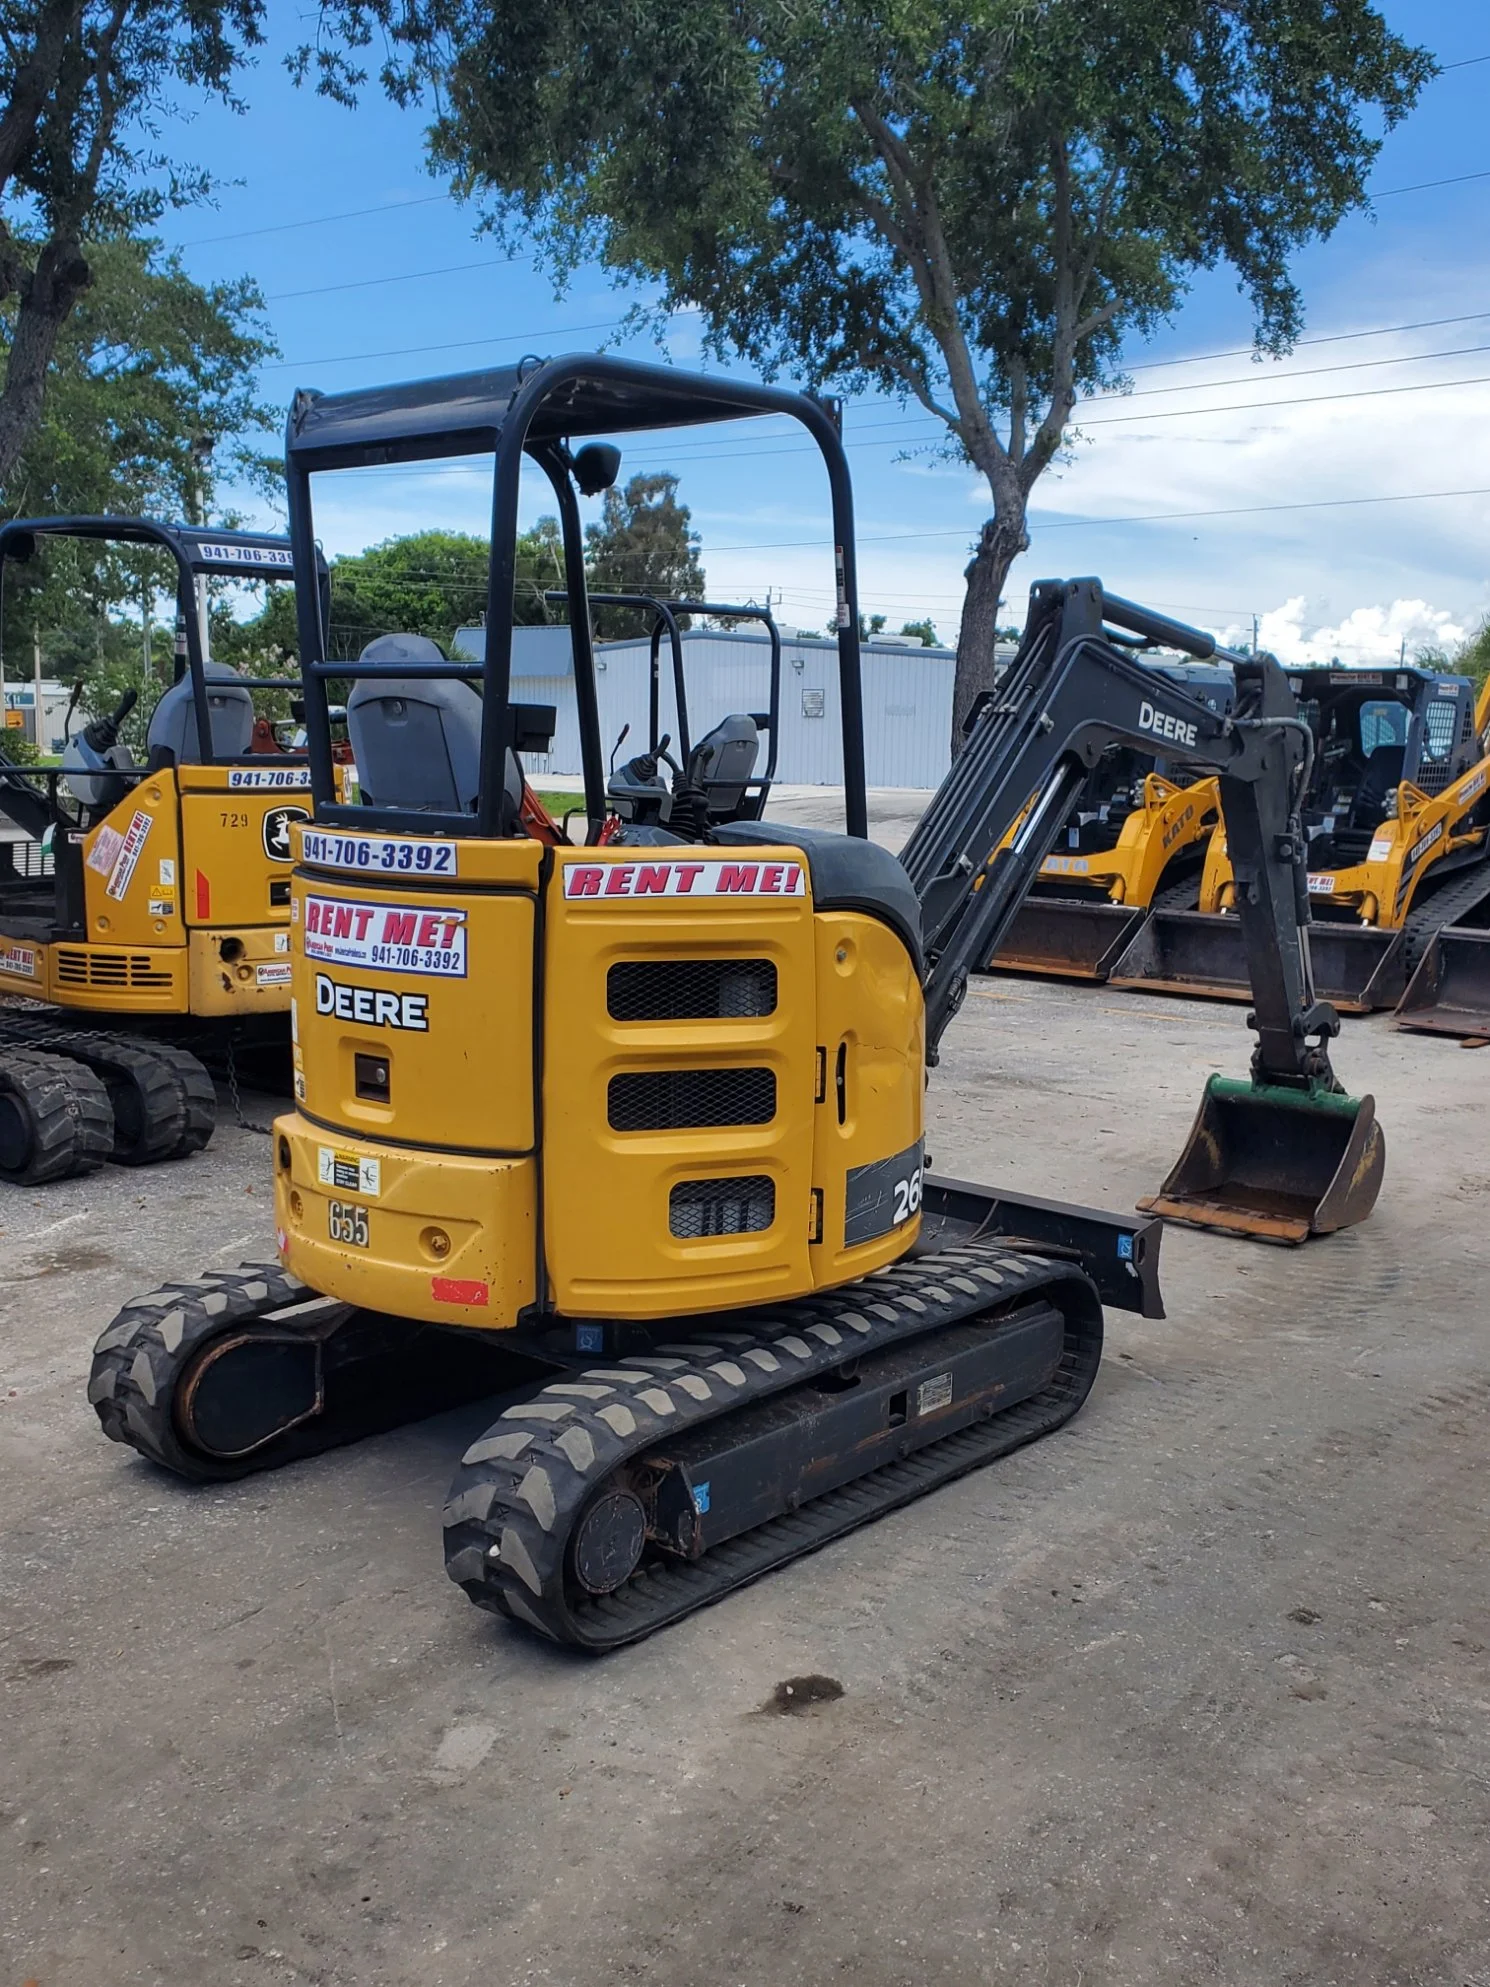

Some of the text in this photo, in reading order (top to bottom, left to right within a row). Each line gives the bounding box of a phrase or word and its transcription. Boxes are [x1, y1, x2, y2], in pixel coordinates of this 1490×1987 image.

[1138, 700, 1198, 747] DEERE
[231, 771, 311, 787] 941-706-3
[123, 829, 138, 854] RENT
[132, 811, 145, 832] ME!
[220, 813, 248, 828] 729
[1162, 803, 1194, 850] KATO
[304, 835, 451, 871] 941-706-3392
[568, 865, 800, 896] RENT ME!
[307, 902, 375, 941] RENT
[382, 912, 460, 949] ME!
[372, 945, 460, 970] 941-706-3392
[315, 973, 429, 1030] DEERE
[330, 1202, 368, 1246] 655
